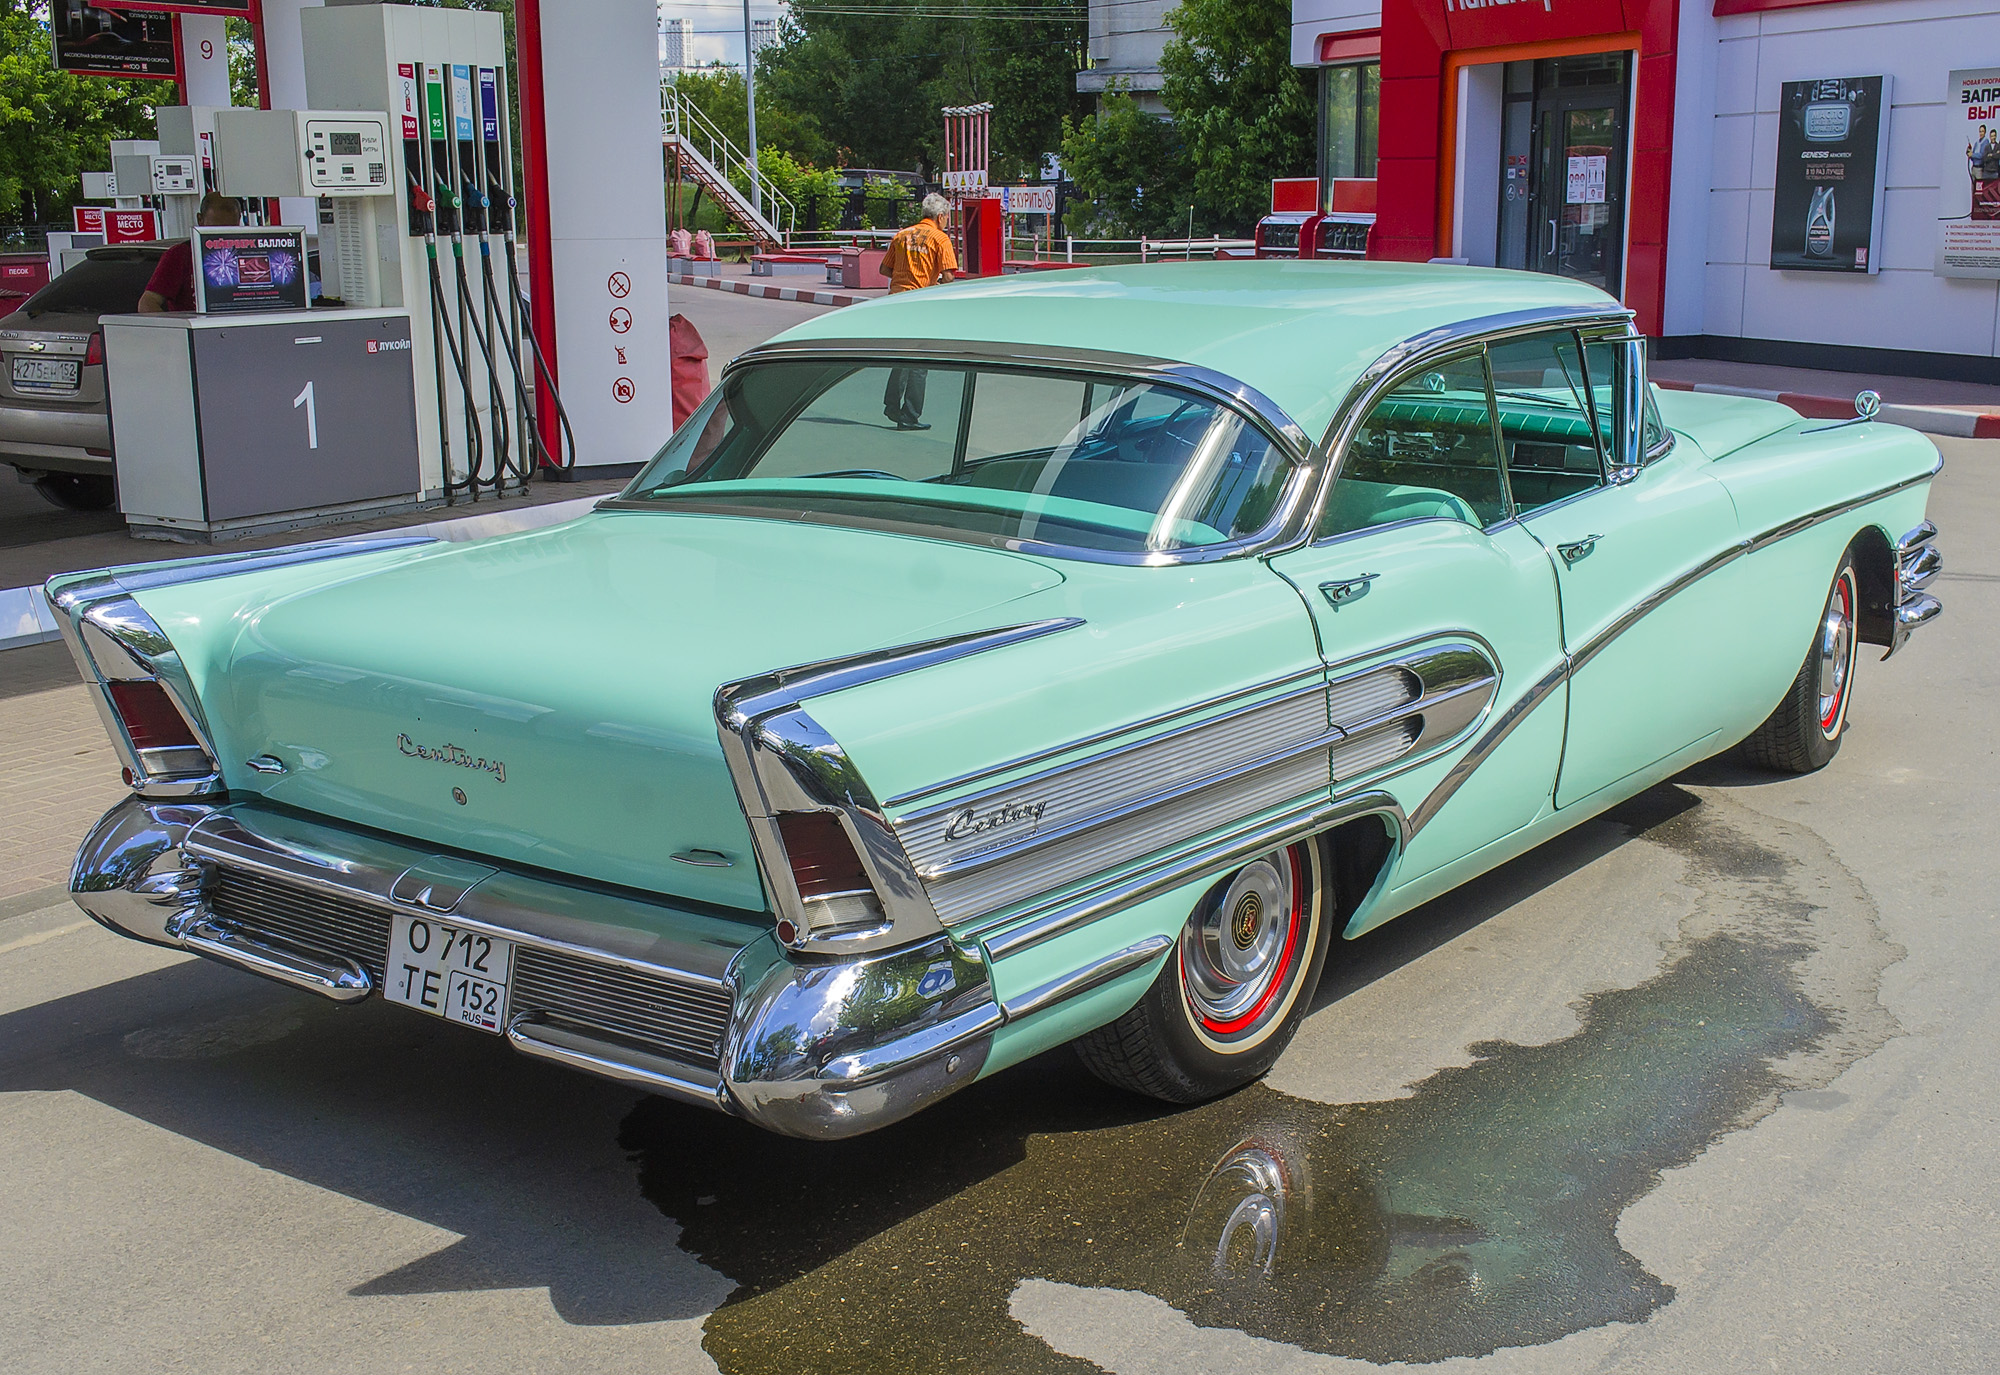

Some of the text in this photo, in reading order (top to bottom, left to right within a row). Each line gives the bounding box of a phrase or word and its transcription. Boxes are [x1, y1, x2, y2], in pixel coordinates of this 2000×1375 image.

[200, 40, 213, 60] 9
[432, 119, 441, 127] 95
[485, 122, 495, 132] ДТ
[117, 221, 144, 229] МЕСТО
[205, 238, 295, 249] ФЕЙЕРВЕРК БАЛЛОВ!
[379, 339, 411, 351] ЛУКОЙЛ
[293, 381, 317, 449] 1
[397, 733, 506, 783] Century
[945, 800, 1047, 841] Century
[441, 926, 492, 973] 712
[403, 963, 498, 1016] ТЕ 152
[462, 1010, 482, 1025] RUS
